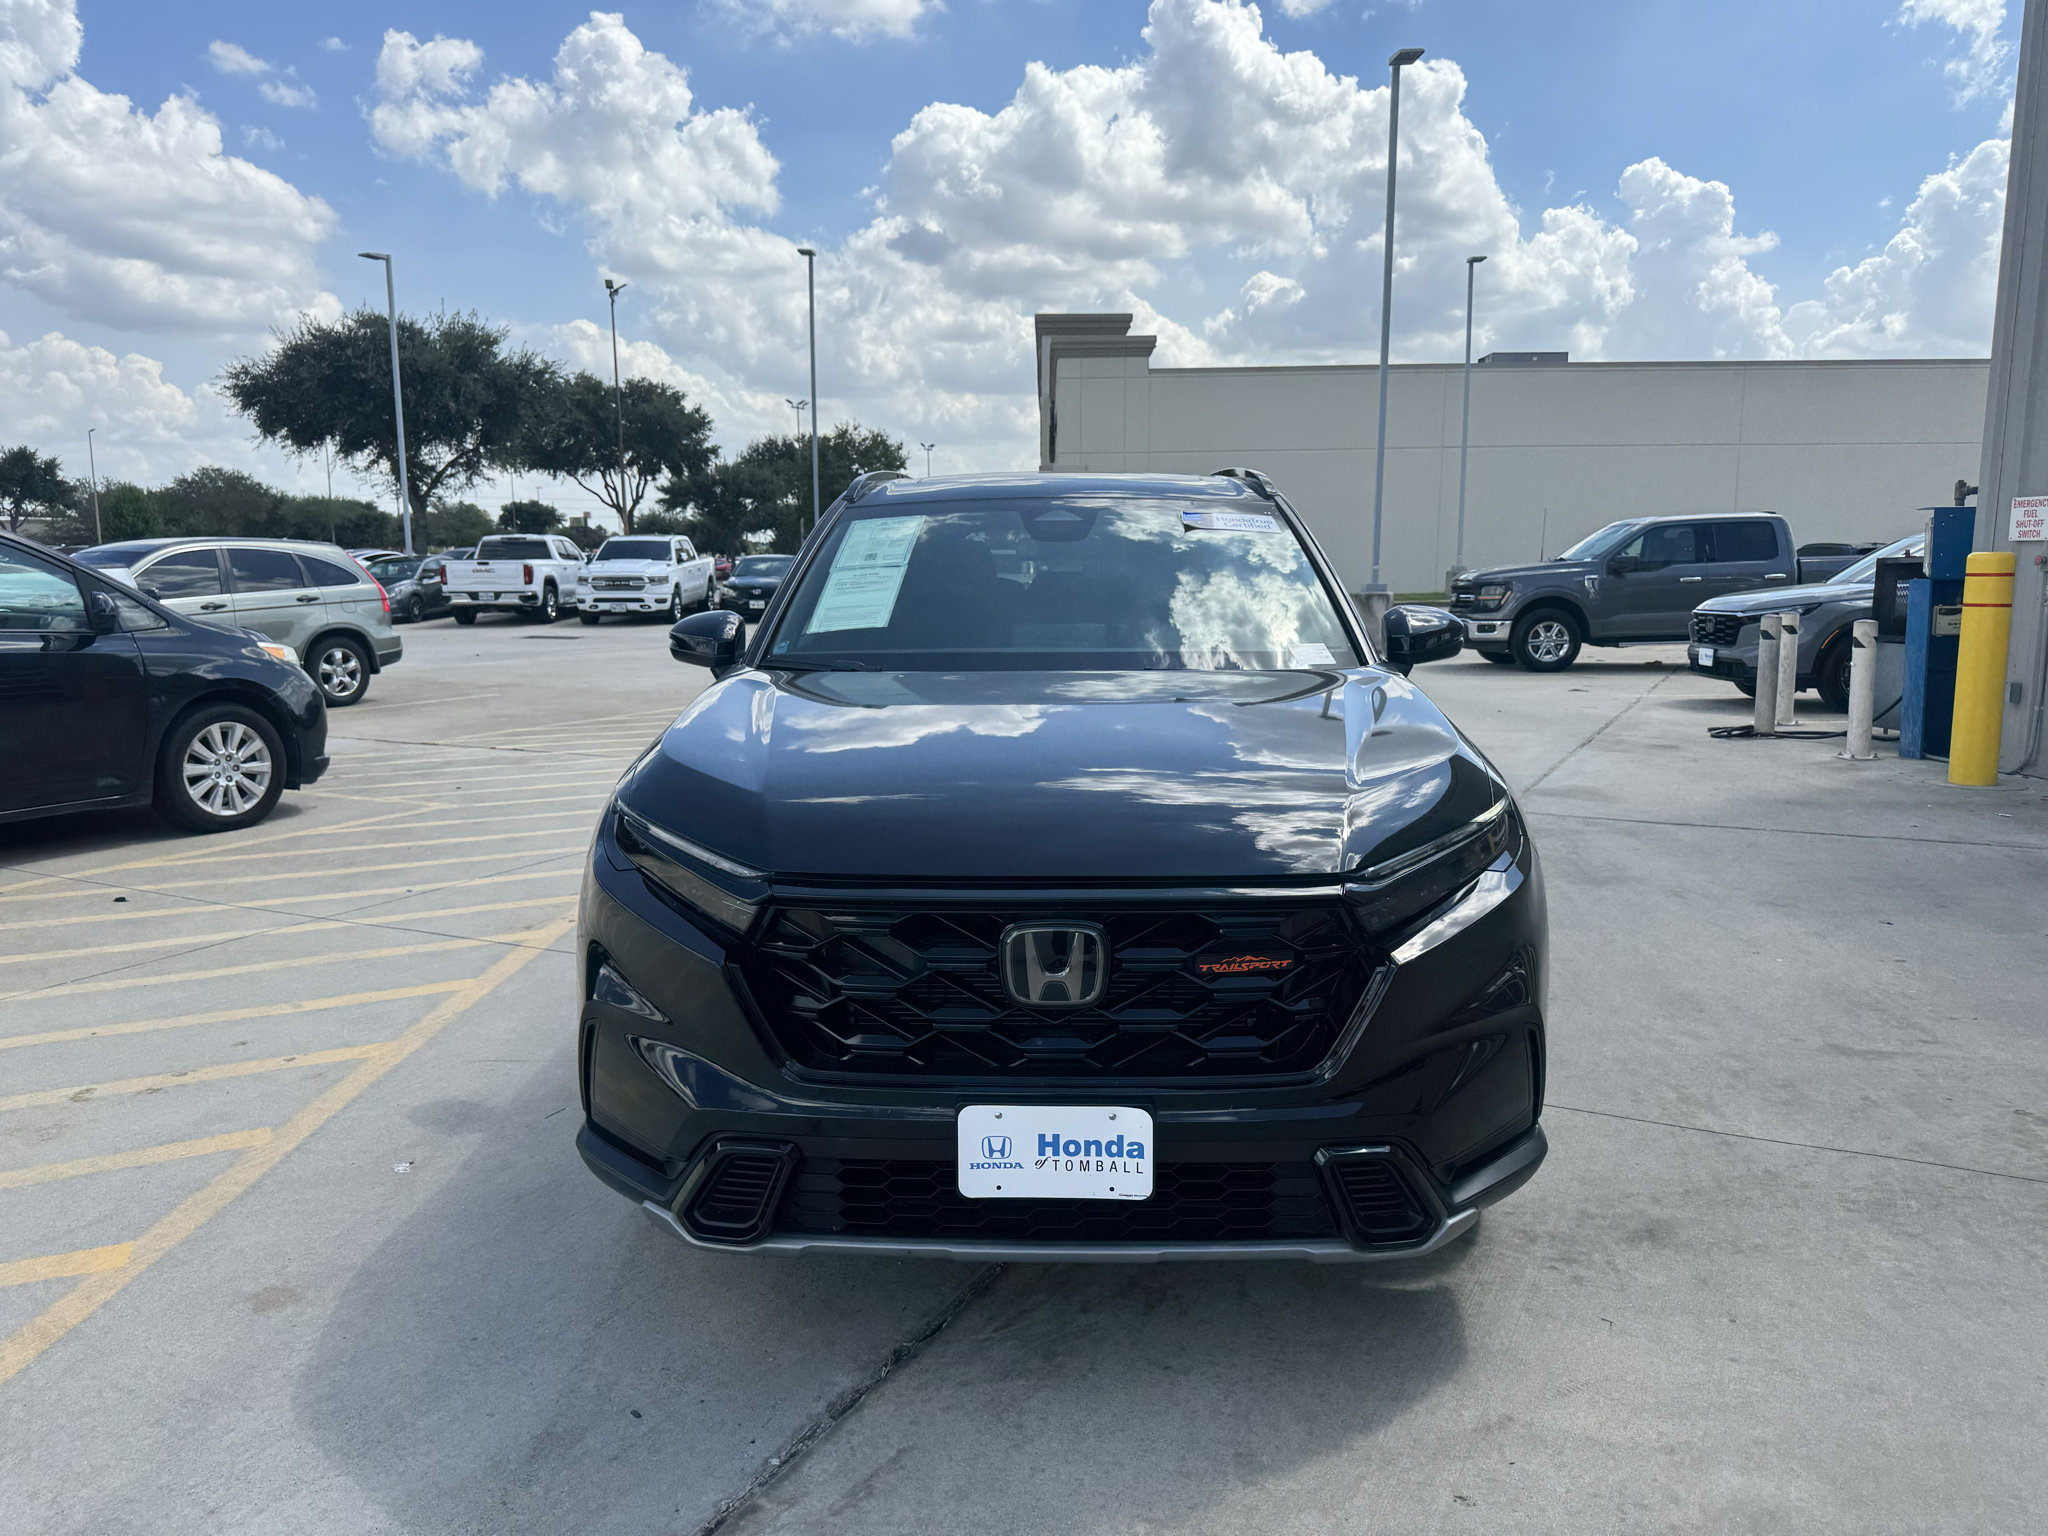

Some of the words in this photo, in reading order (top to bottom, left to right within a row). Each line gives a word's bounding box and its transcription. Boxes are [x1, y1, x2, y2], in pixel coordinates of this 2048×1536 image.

[2013, 499, 2048, 508] EMERGENC
[2023, 509, 2038, 518] FUEL
[1216, 516, 1273, 525] HondaTrue
[2015, 519, 2045, 529] SHUT-OFF
[1223, 522, 1272, 530] Certified
[2017, 530, 2041, 539] SWITCH
[1199, 960, 1292, 972] TRAILSPORT
[1037, 1133, 1145, 1160] Honda
[969, 1162, 1025, 1170] HONDA
[1034, 1156, 1051, 1170] of
[1052, 1159, 1144, 1174] TOMBALL
